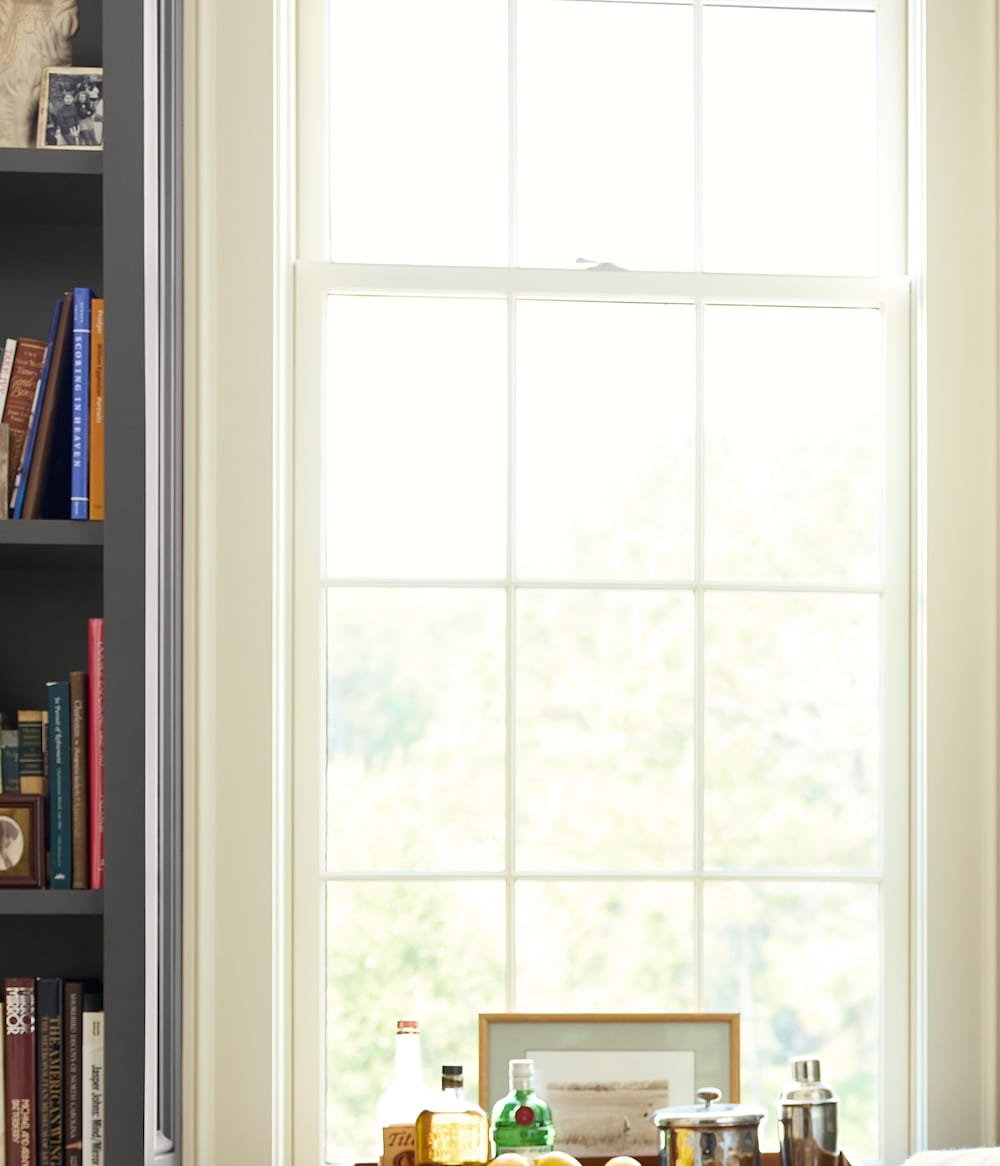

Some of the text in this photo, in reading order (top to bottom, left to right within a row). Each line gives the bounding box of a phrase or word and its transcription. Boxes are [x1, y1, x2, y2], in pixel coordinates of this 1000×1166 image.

[73, 336, 82, 468] SCORING IN HEAVEN
[6, 987, 20, 1035] MIRROR
[49, 1015, 61, 1166] THE AMERICAN WING
[70, 1073, 78, 1100] NORTH
[91, 1064, 102, 1090] Jasper
[70, 1101, 78, 1138] CAROLINA
